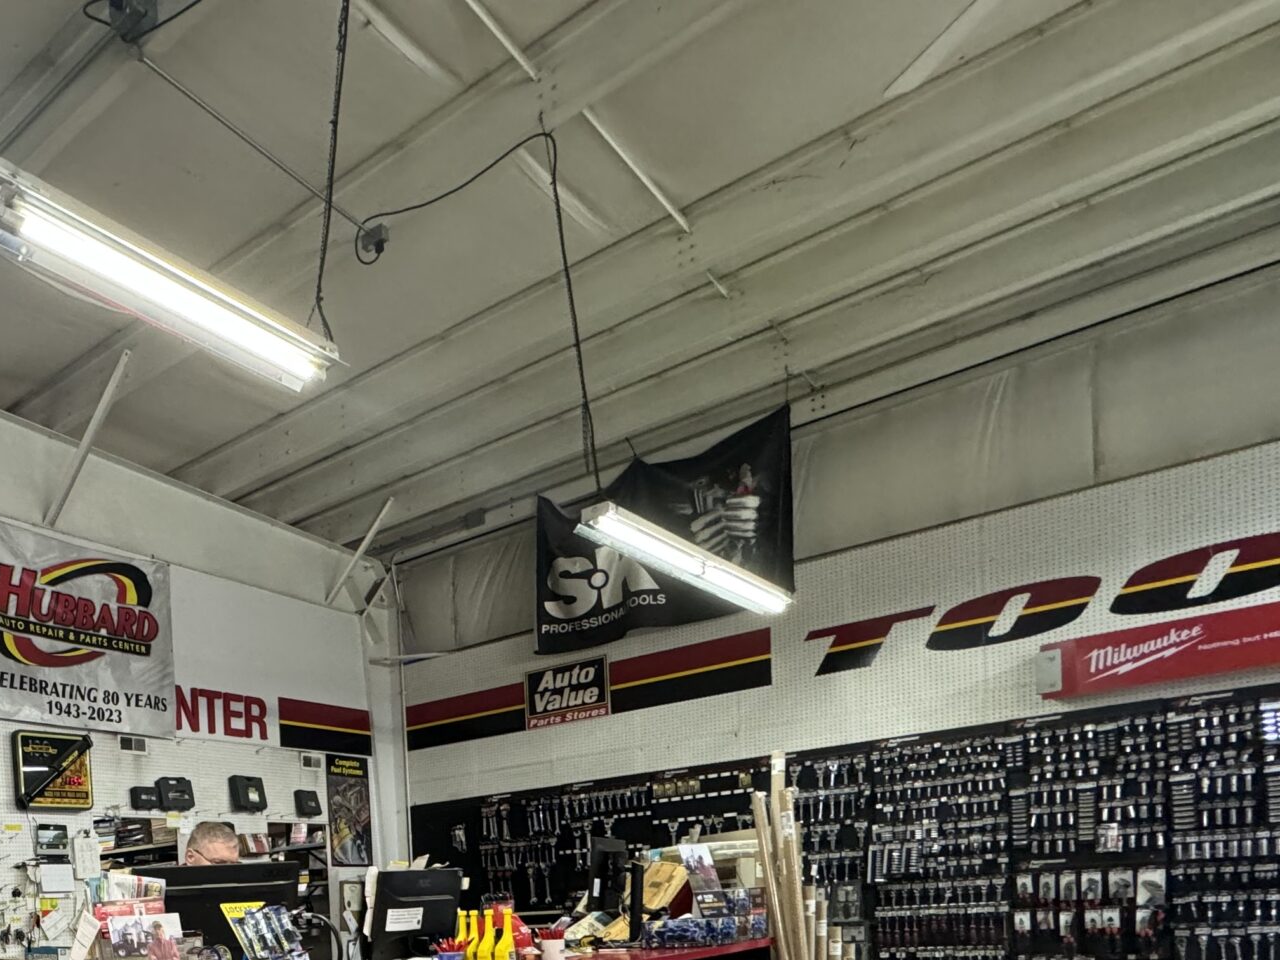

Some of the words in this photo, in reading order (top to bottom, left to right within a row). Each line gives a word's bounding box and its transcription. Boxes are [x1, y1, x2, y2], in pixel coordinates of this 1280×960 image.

[541, 608, 626, 634] PROFESSIONA
[628, 594, 666, 607] OOLS
[29, 623, 65, 639] REPAIR
[68, 632, 75, 641] &
[79, 634, 108, 647] PARTS
[112, 640, 146, 654] CENTER
[1080, 624, 1204, 673] Milwaukee
[537, 664, 595, 692] Auto
[46, 700, 122, 724] 1943-2023
[102, 689, 120, 706] 80
[124, 692, 168, 712] YEARS
[534, 685, 599, 713] Value
[529, 715, 568, 729] Parts
[569, 707, 607, 722] Stores
[334, 758, 360, 768] Complete
[342, 768, 364, 776] Systems
